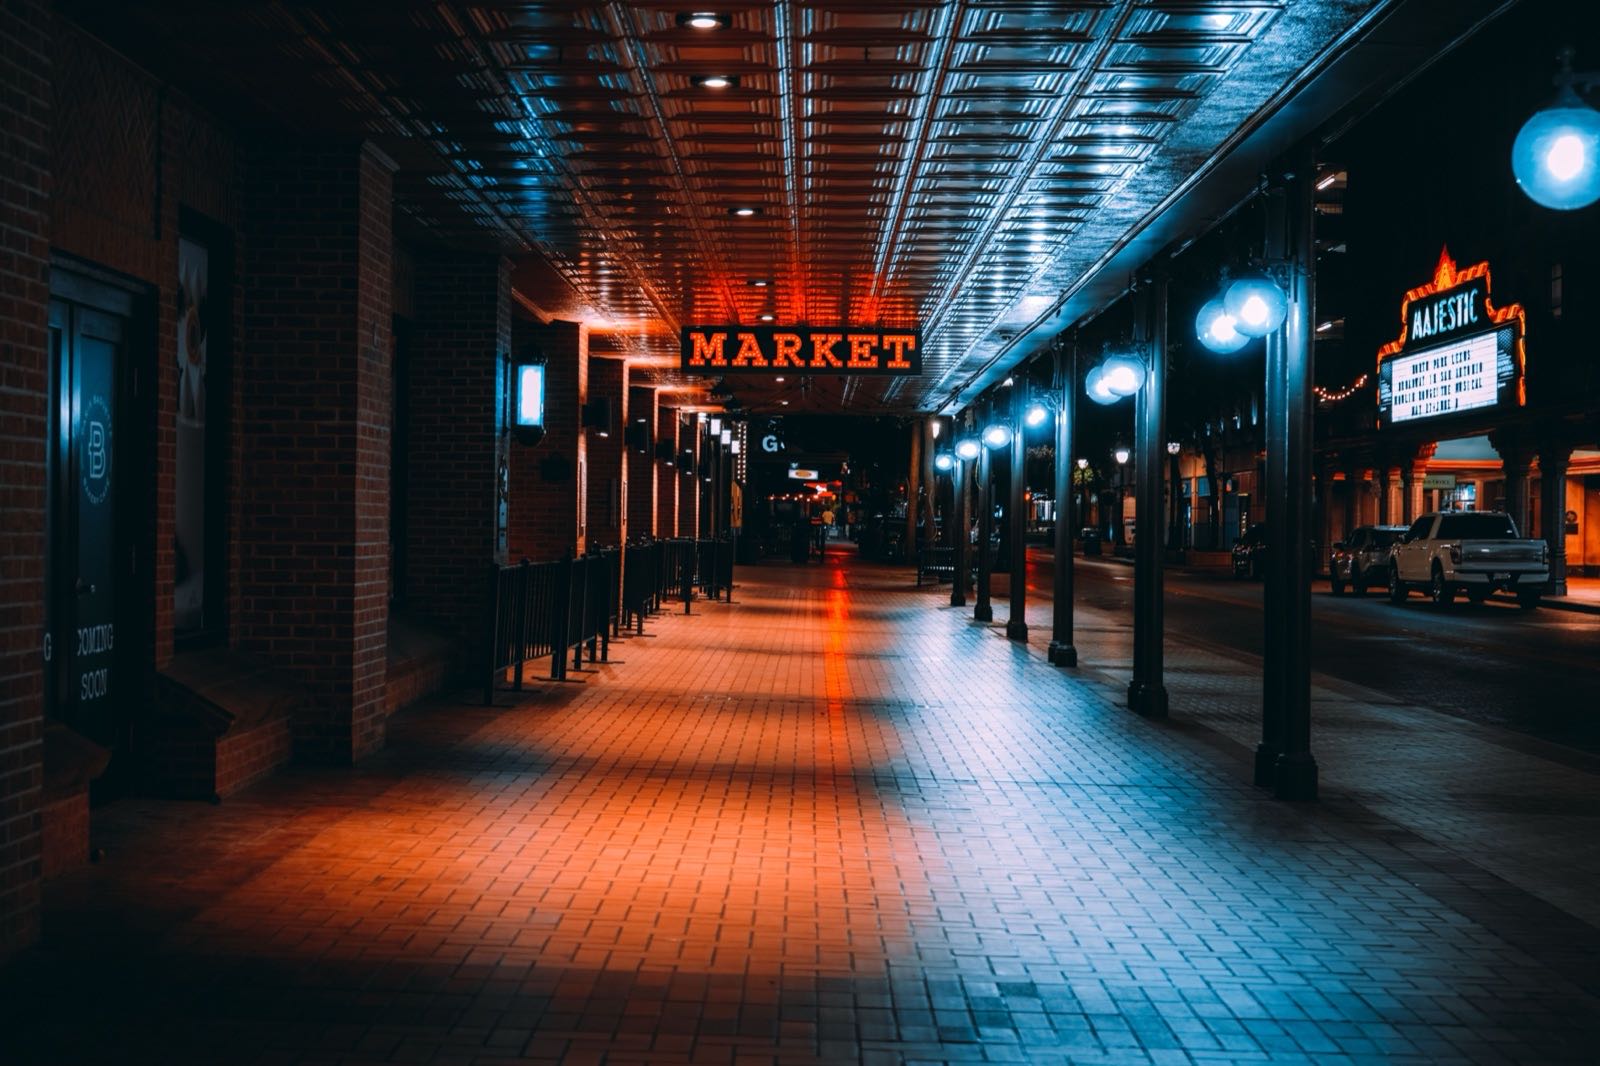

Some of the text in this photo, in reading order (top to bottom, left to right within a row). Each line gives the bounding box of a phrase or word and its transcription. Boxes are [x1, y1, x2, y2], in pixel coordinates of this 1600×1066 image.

[1411, 288, 1479, 341] MAJESTIC
[688, 330, 916, 369] MARKET
[1455, 377, 1482, 393] MUSICAL
[88, 421, 106, 478] B
[81, 668, 107, 700] SOON
